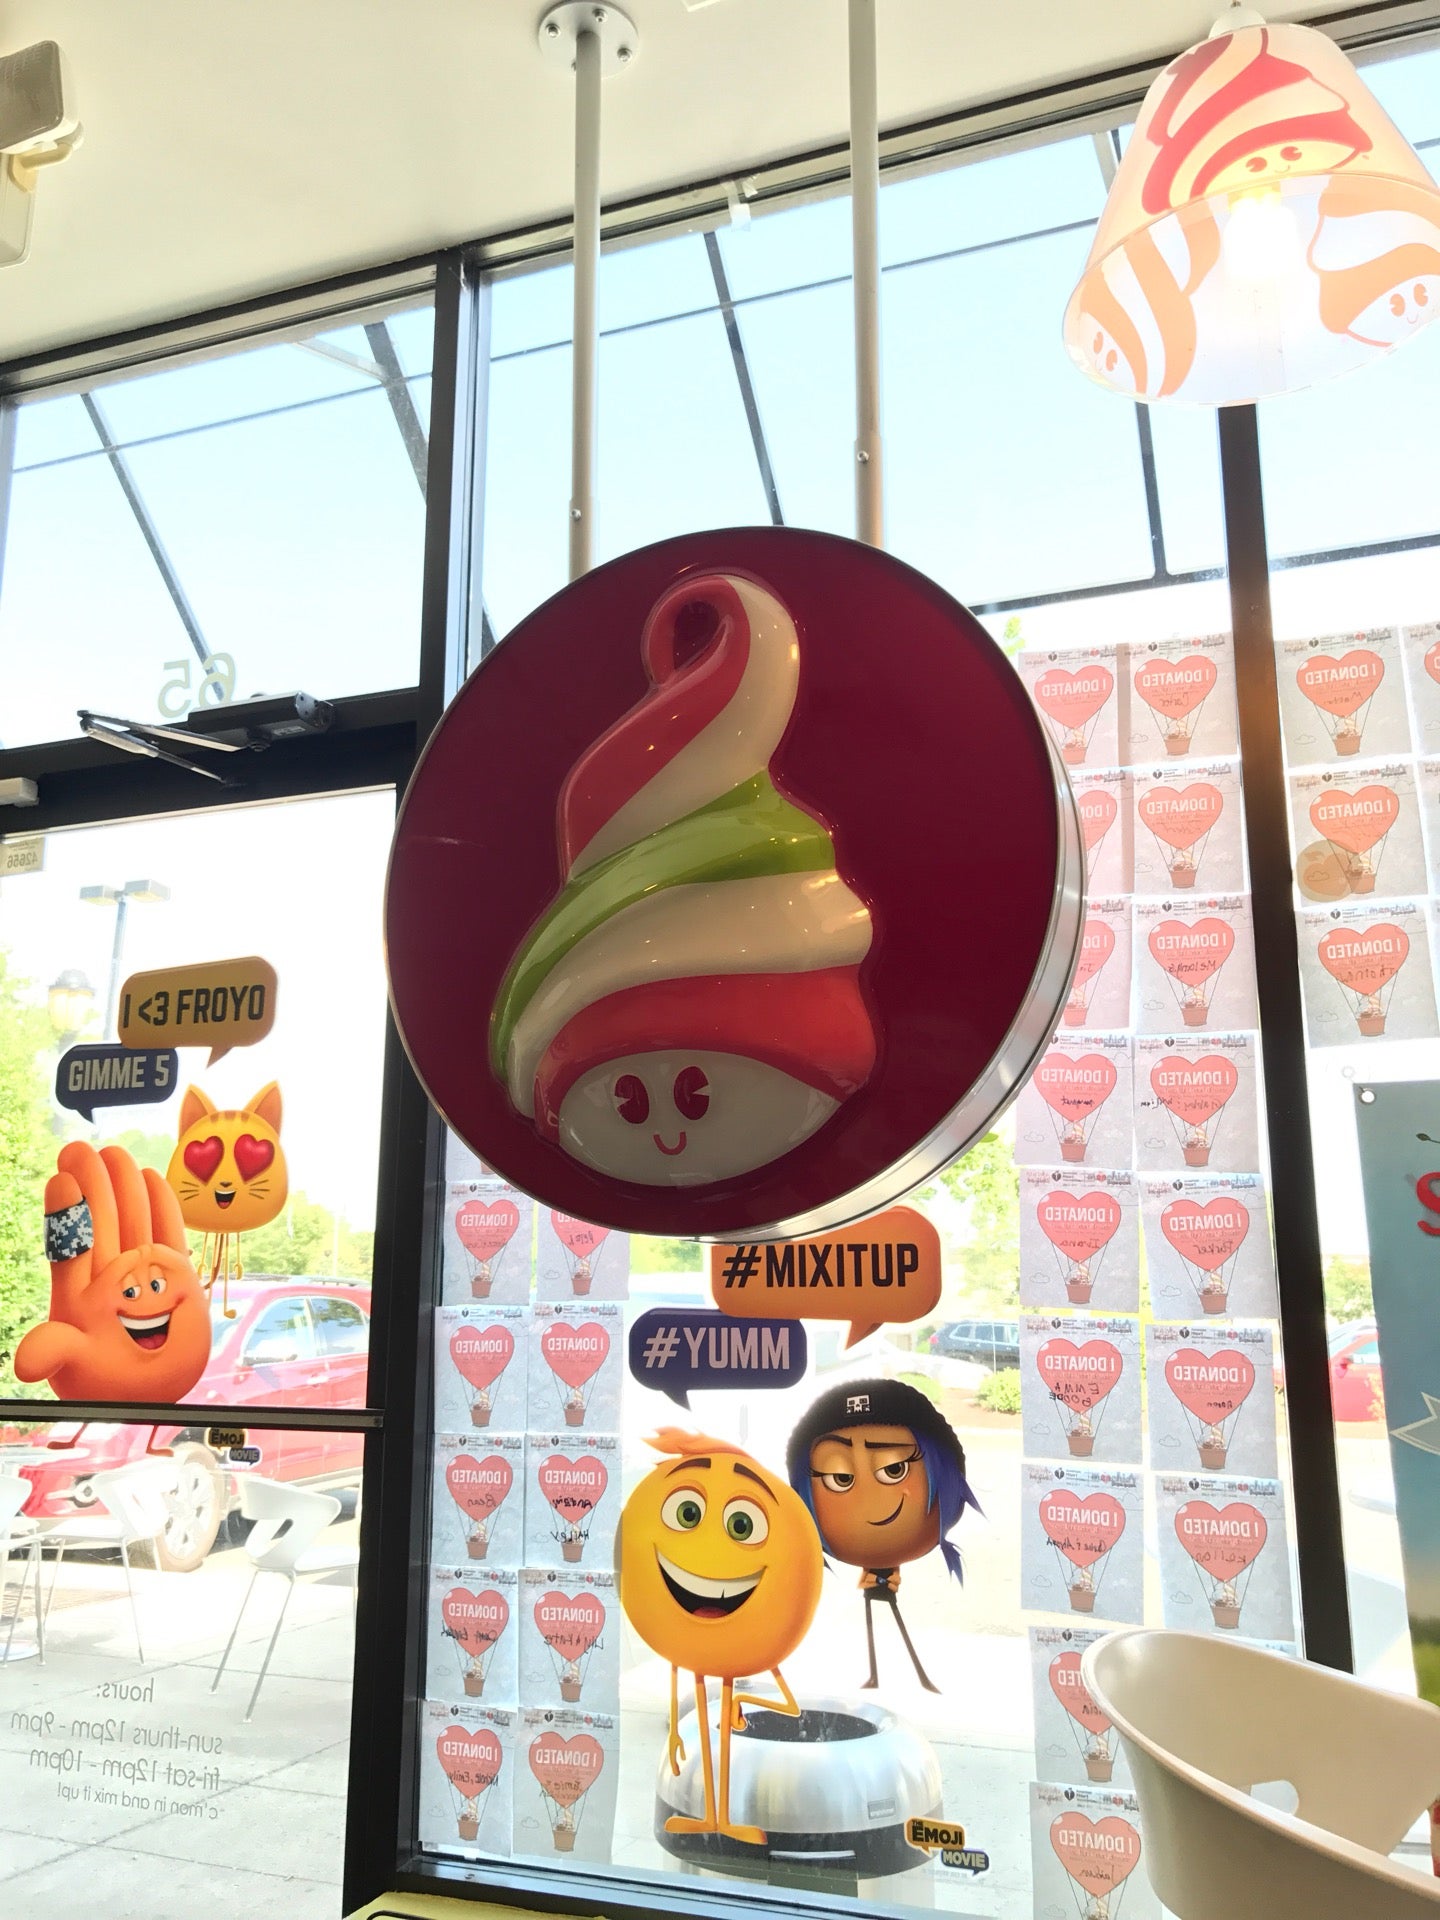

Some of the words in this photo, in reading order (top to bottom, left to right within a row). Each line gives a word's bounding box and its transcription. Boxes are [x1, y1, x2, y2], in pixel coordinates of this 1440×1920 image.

[123, 994, 131, 1028] I
[176, 985, 265, 1024] FROYO
[68, 1056, 146, 1091] GIMME
[155, 1053, 169, 1087] 5
[722, 1243, 919, 1288] #MIXITUP
[642, 1327, 790, 1370] #YUMM
[212, 1432, 245, 1444] EMOJI
[231, 1450, 258, 1460] MOVIE
[912, 1826, 962, 1845] EMOJI
[943, 1851, 985, 1868] MOVIE
